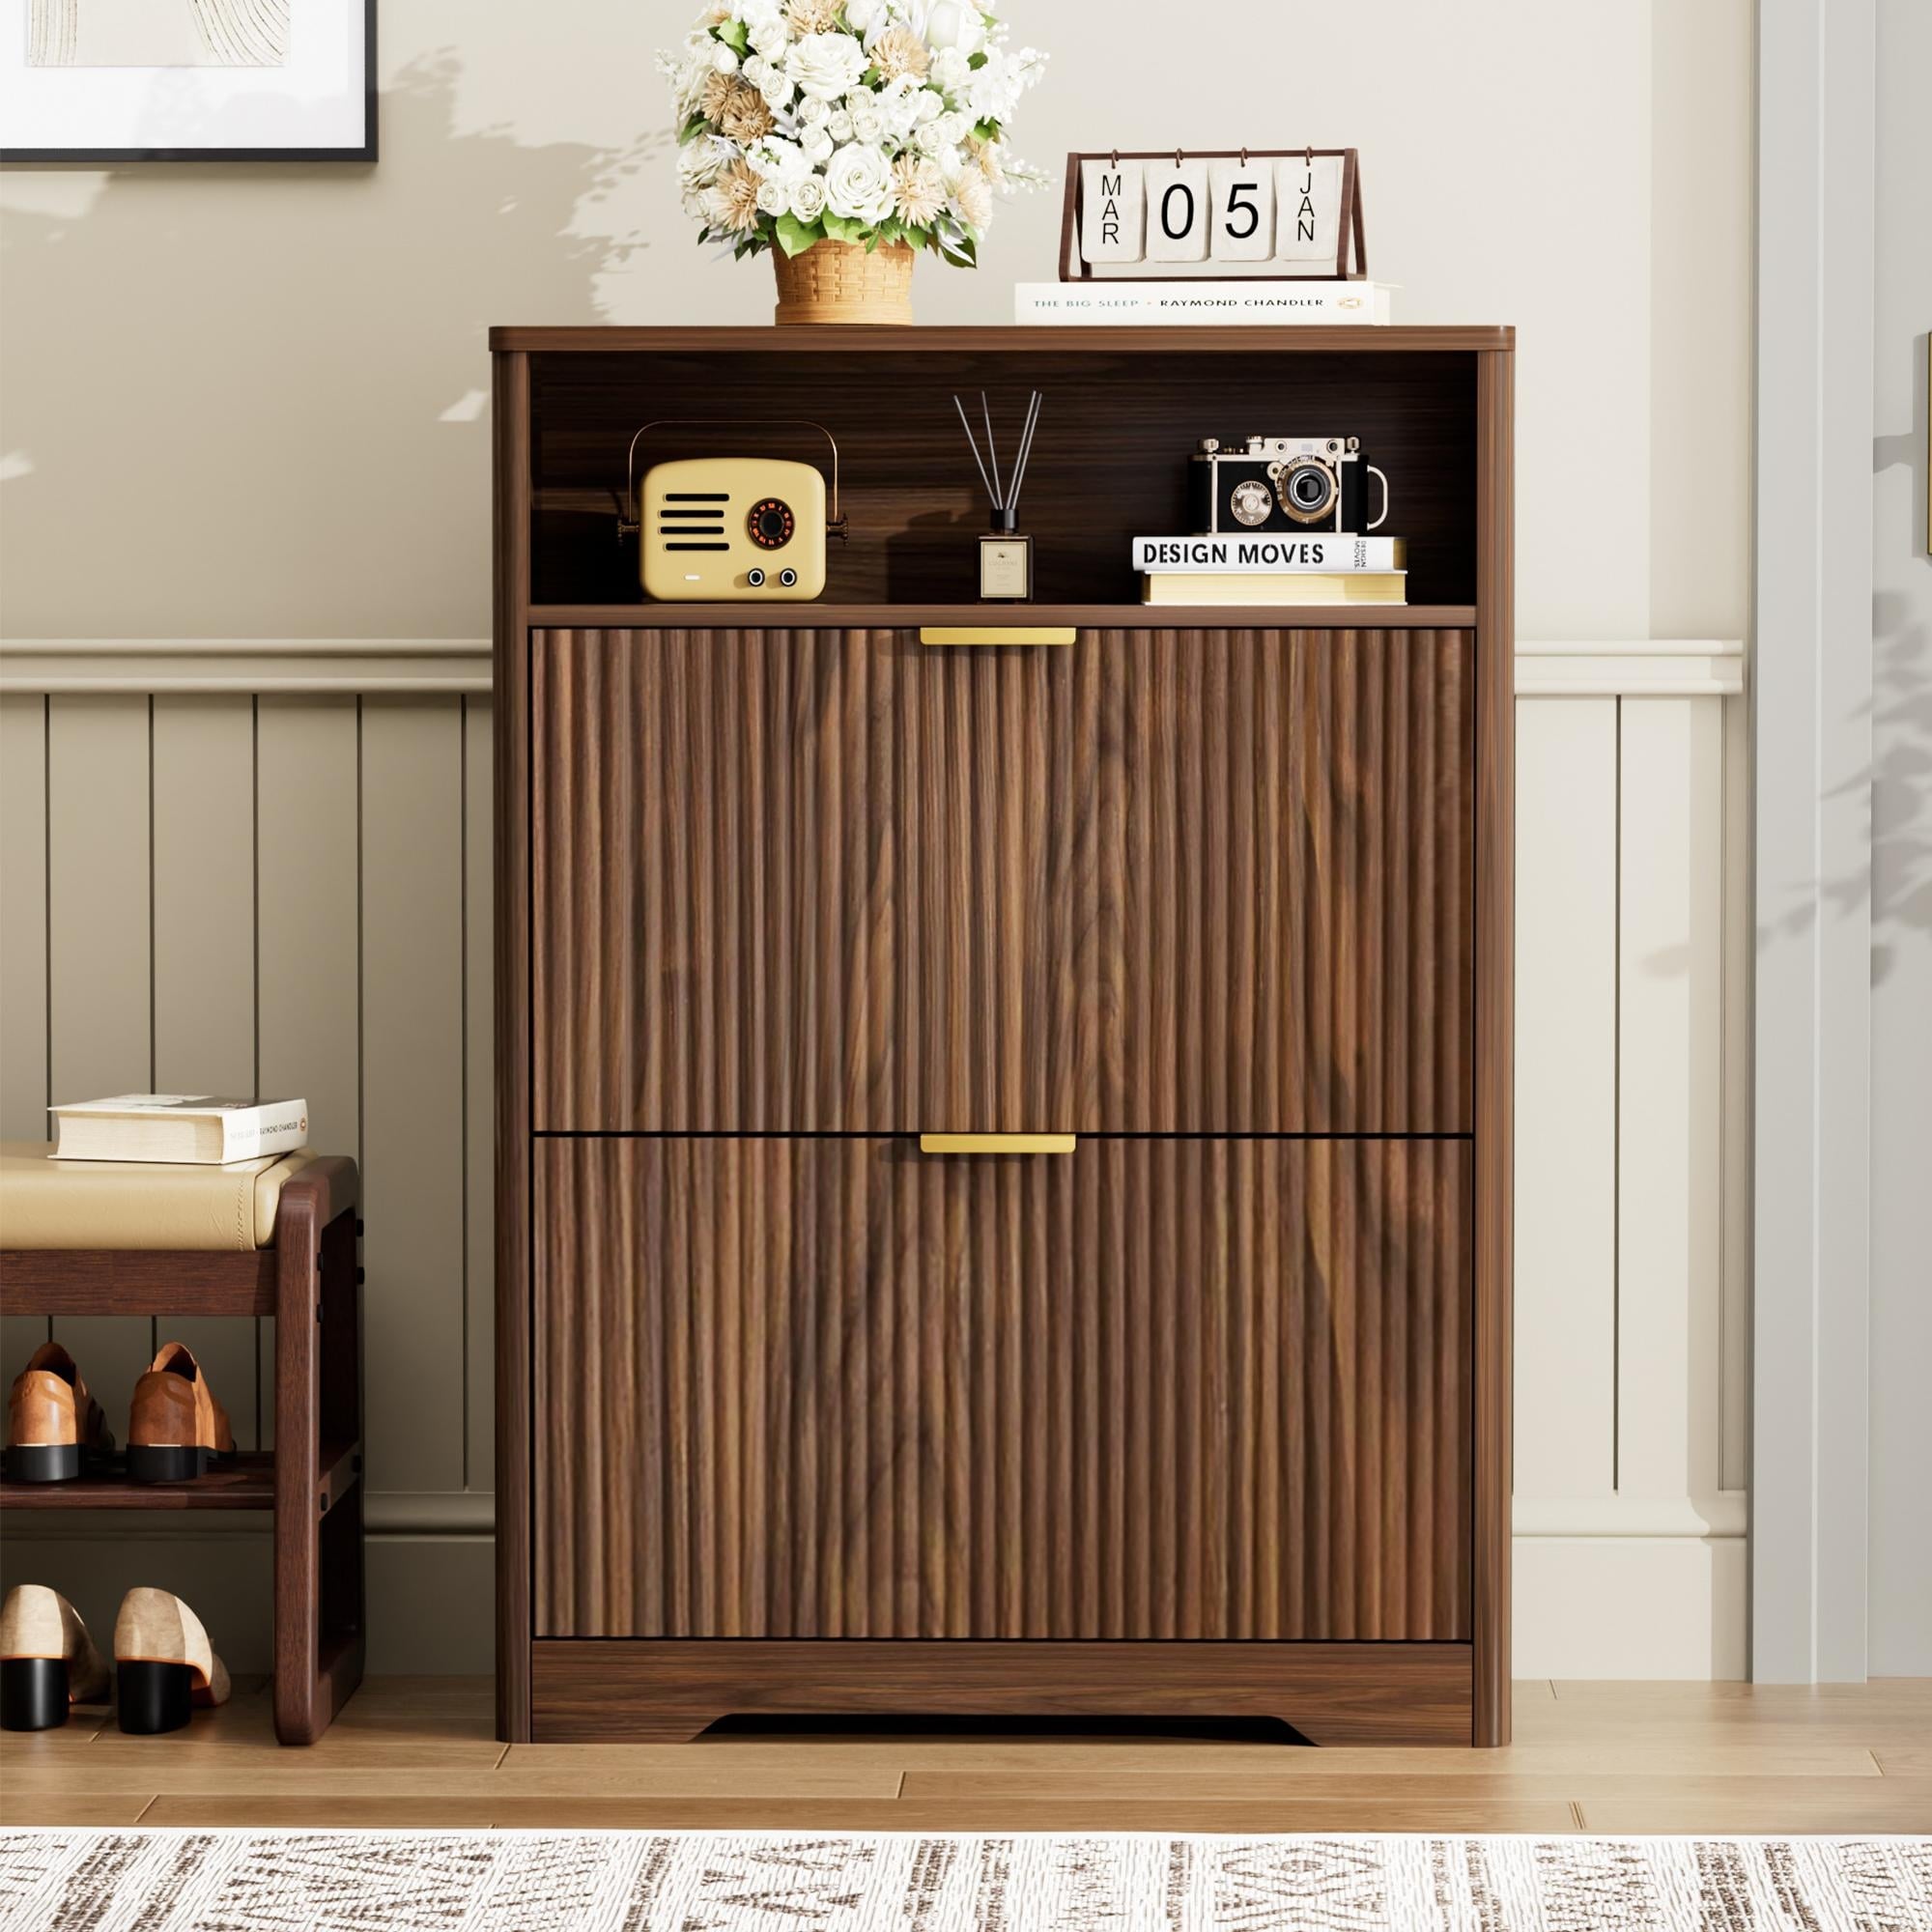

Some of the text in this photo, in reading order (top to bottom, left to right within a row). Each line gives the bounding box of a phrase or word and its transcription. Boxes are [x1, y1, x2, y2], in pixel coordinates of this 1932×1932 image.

[1101, 174, 1122, 244] MAR
[1296, 172, 1315, 242] JAN
[1159, 298, 1238, 307] RAYMOND
[1243, 298, 1324, 307] CHANDLER
[1143, 543, 1324, 564] DESIGN MOVES
